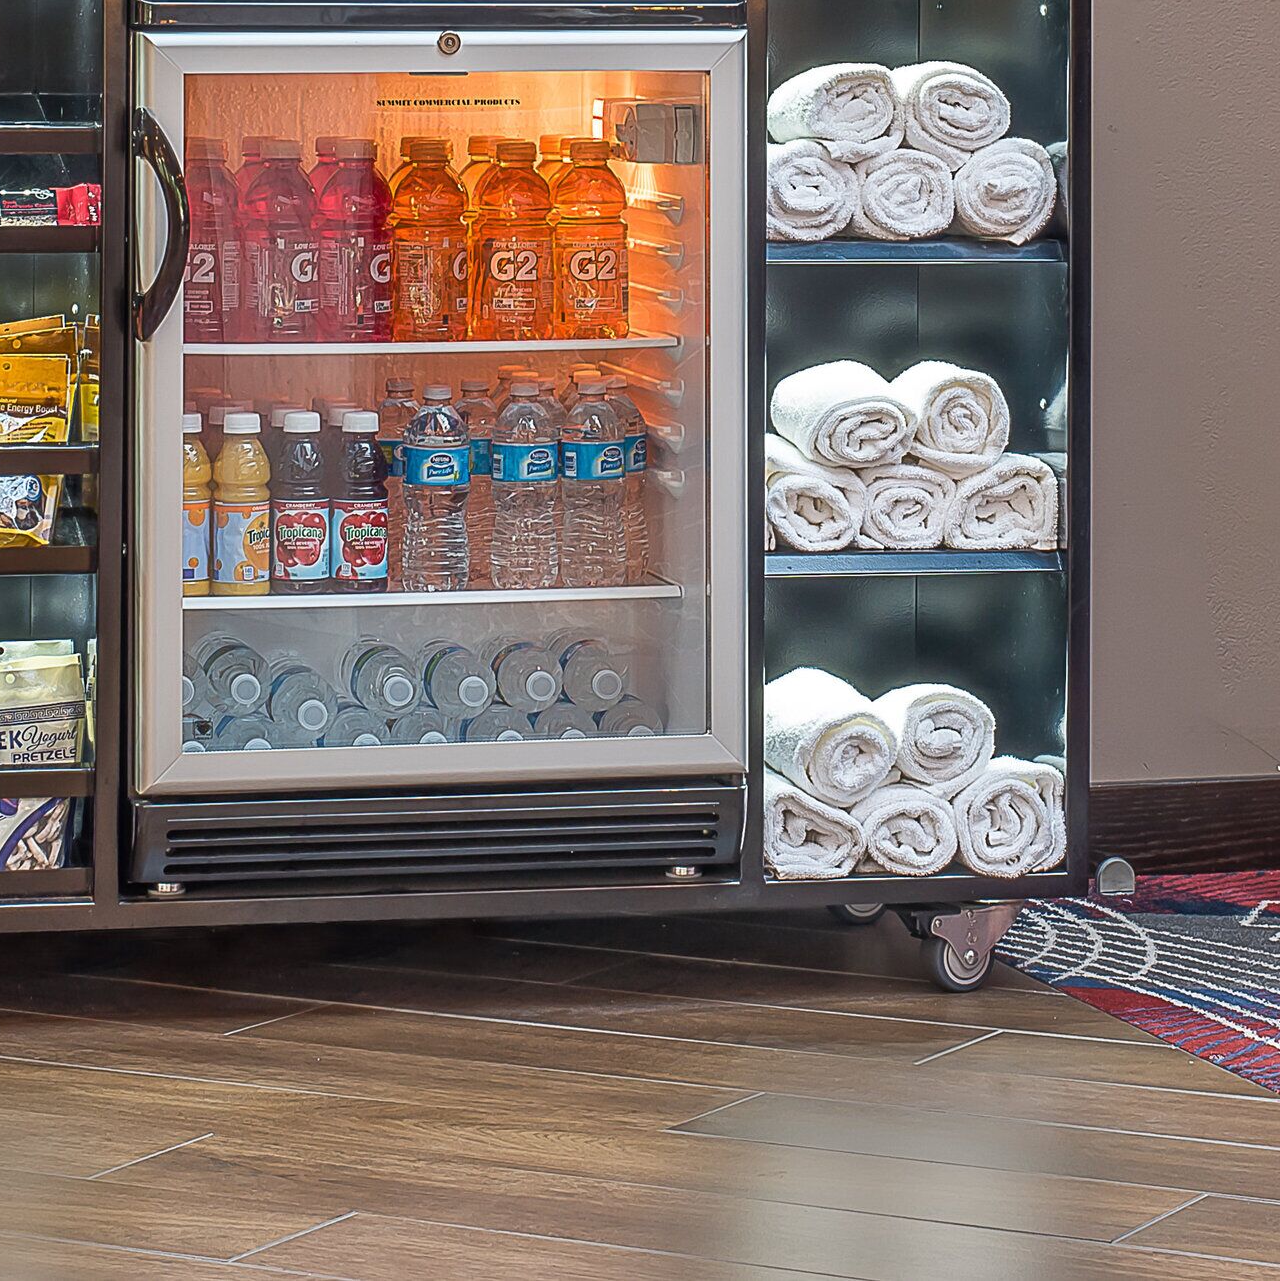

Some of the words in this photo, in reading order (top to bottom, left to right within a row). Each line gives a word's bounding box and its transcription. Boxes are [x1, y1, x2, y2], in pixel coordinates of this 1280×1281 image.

[474, 98, 521, 106] PRODUCTS
[490, 250, 538, 281] G2
[570, 250, 617, 281] G2
[7, 403, 34, 414] Energy
[35, 405, 58, 414] Boost
[278, 525, 323, 541] Tropicana
[345, 526, 388, 541] Tropicana
[21, 725, 77, 751] Yogurt
[13, 748, 77, 764] PRETZELS
